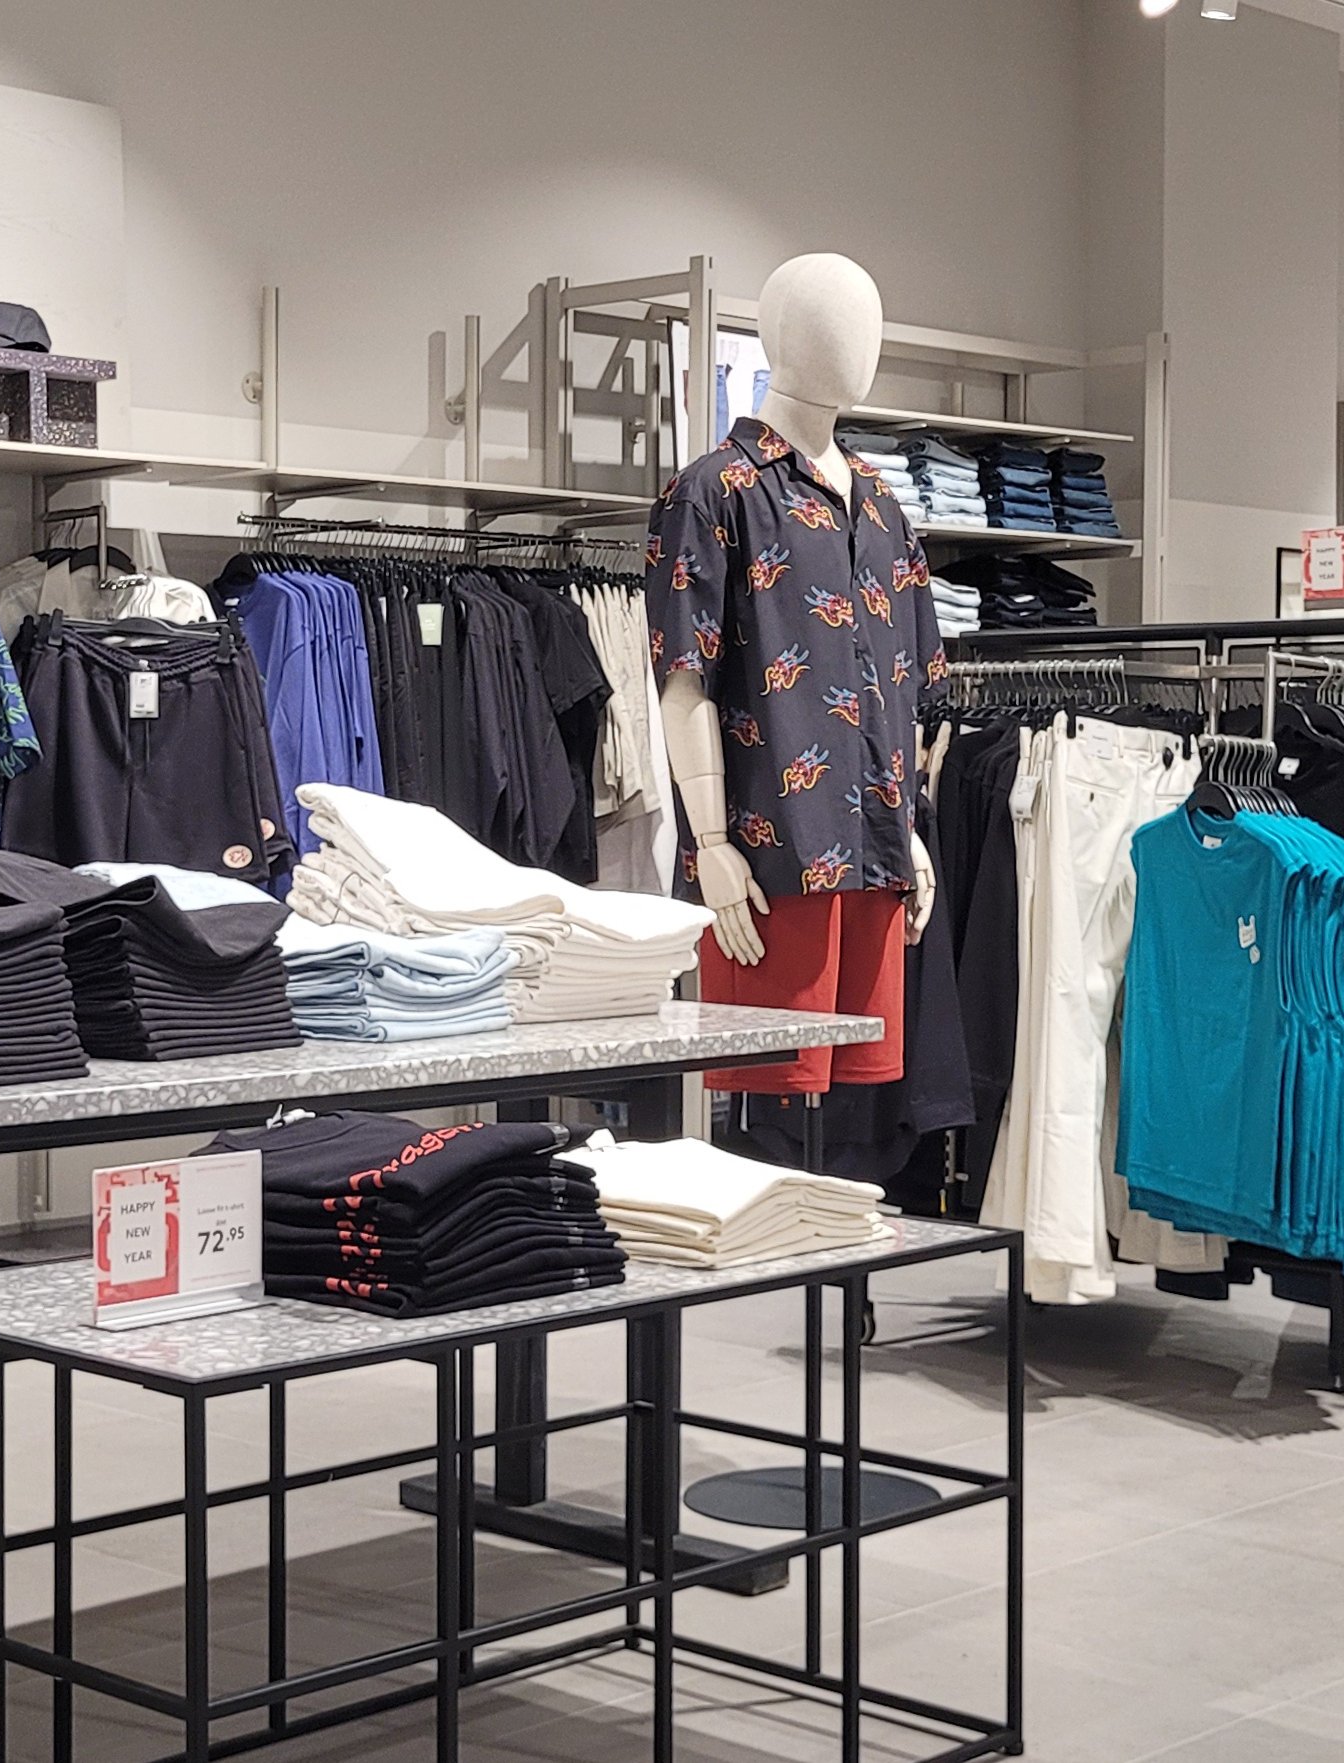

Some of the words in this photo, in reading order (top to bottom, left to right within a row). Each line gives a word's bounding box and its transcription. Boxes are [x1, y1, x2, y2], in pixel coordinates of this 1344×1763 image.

[120, 1201, 157, 1216] HAPPY
[125, 1226, 152, 1240] NEW
[124, 1250, 153, 1265] YEAR
